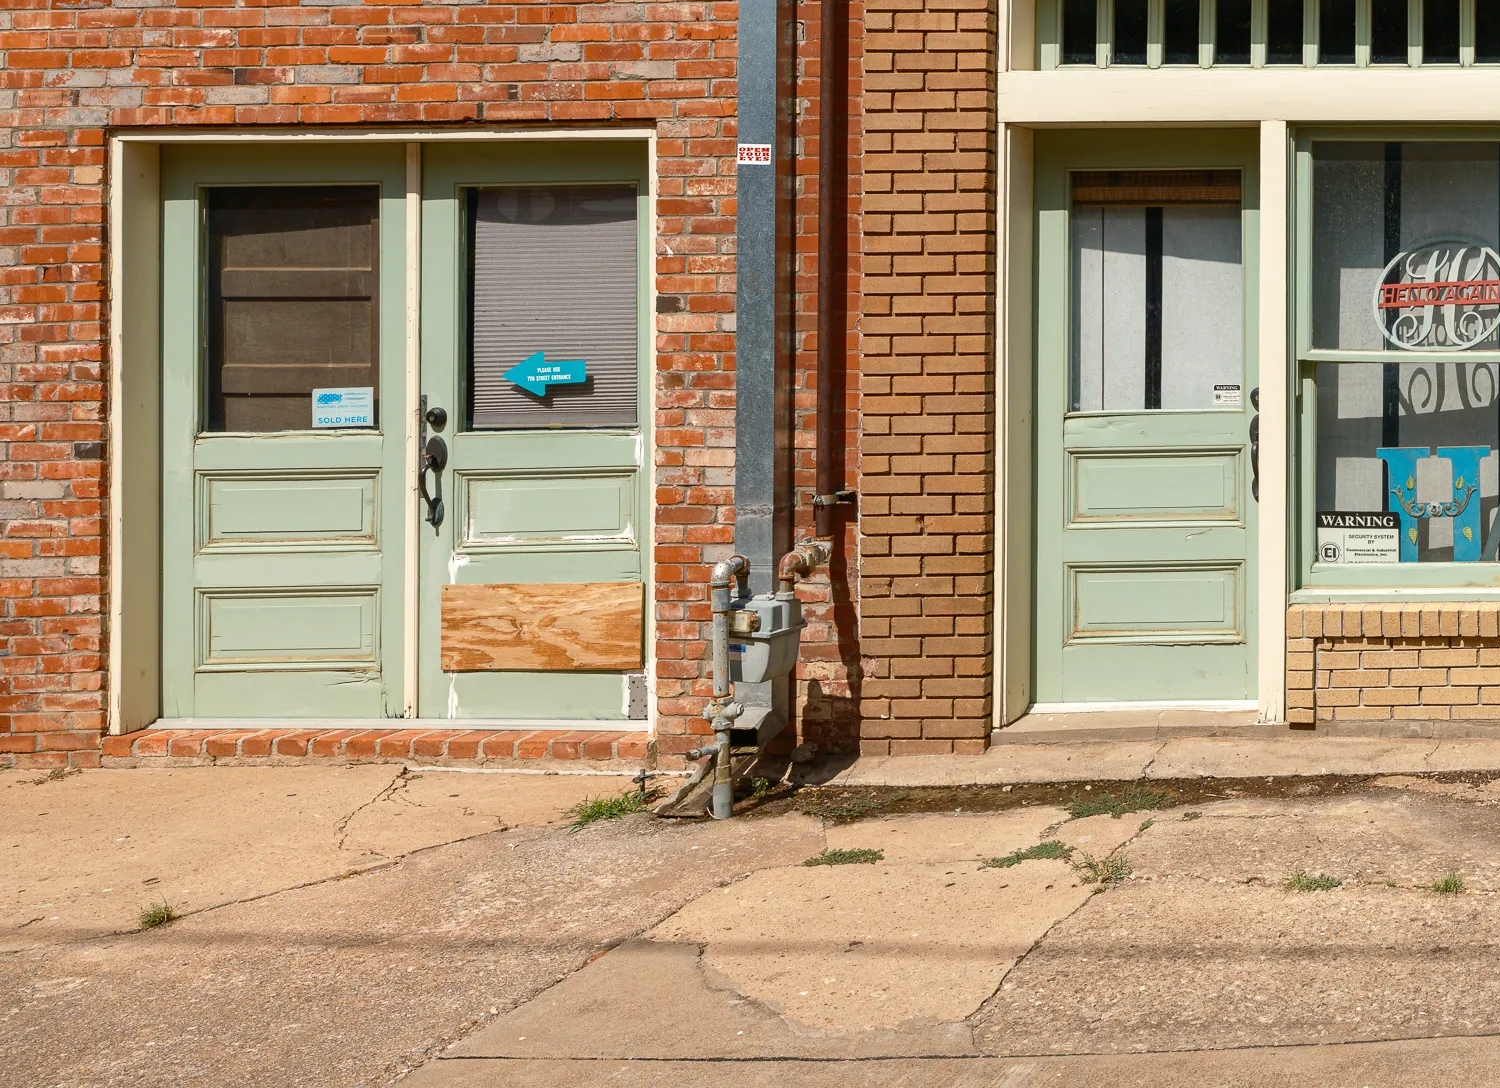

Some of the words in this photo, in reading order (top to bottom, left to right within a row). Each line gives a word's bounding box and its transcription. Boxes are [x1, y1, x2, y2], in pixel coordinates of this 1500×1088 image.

[1383, 286, 1439, 305] HELLO
[317, 416, 342, 424] SOLD
[344, 415, 368, 423] HERE
[1321, 515, 1395, 527] WARNING
